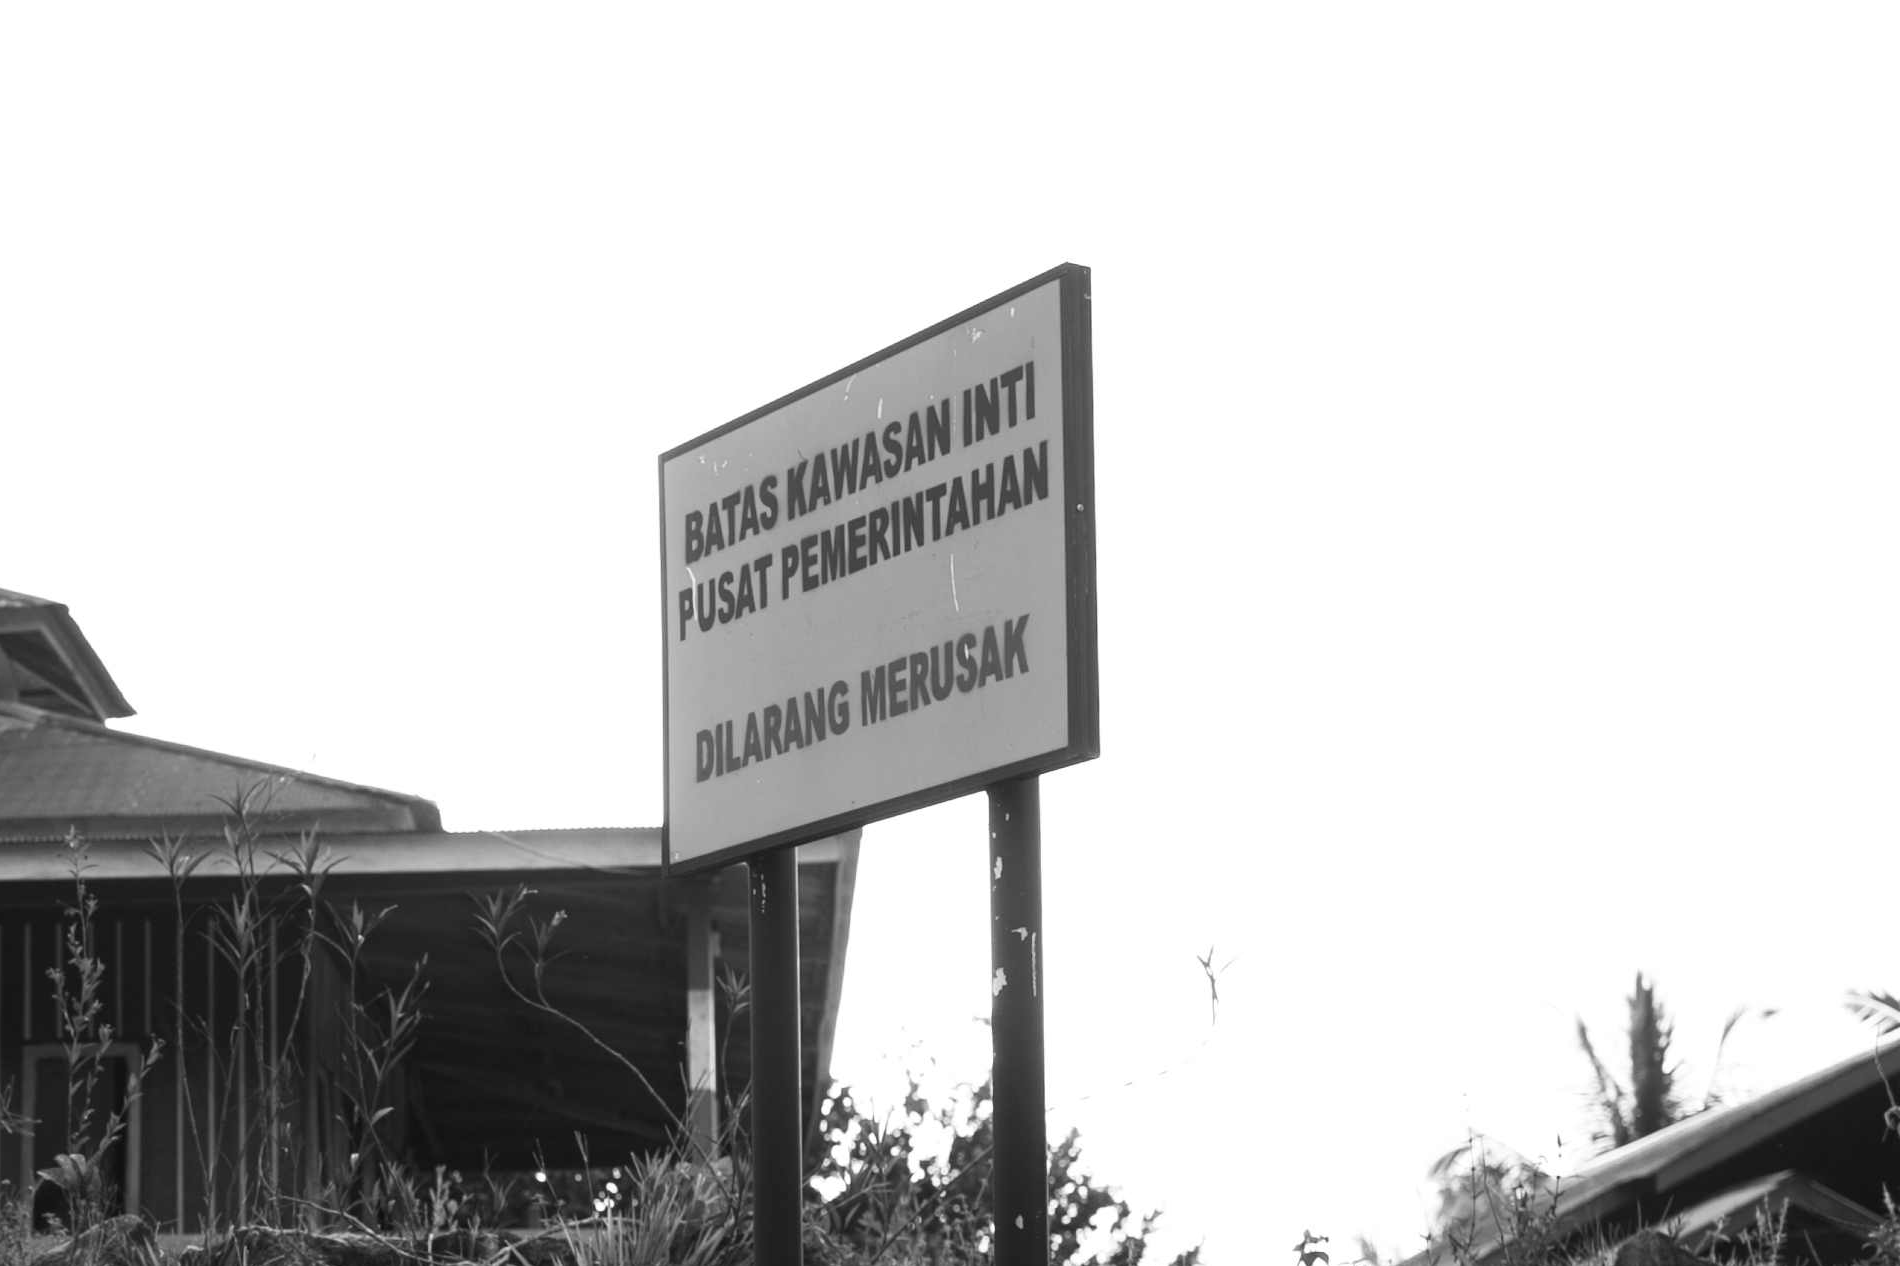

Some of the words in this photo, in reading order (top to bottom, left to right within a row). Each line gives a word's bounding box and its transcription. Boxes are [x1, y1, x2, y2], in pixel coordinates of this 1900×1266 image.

[679, 554, 773, 642] PUSAT
[781, 440, 1048, 600] PEMERINTAHAN
[685, 475, 778, 564] BATAS
[787, 399, 951, 520] KAWASAN
[963, 361, 1036, 447] INTI
[697, 680, 849, 783] DILARANG
[861, 614, 1030, 726] MERUSAK
